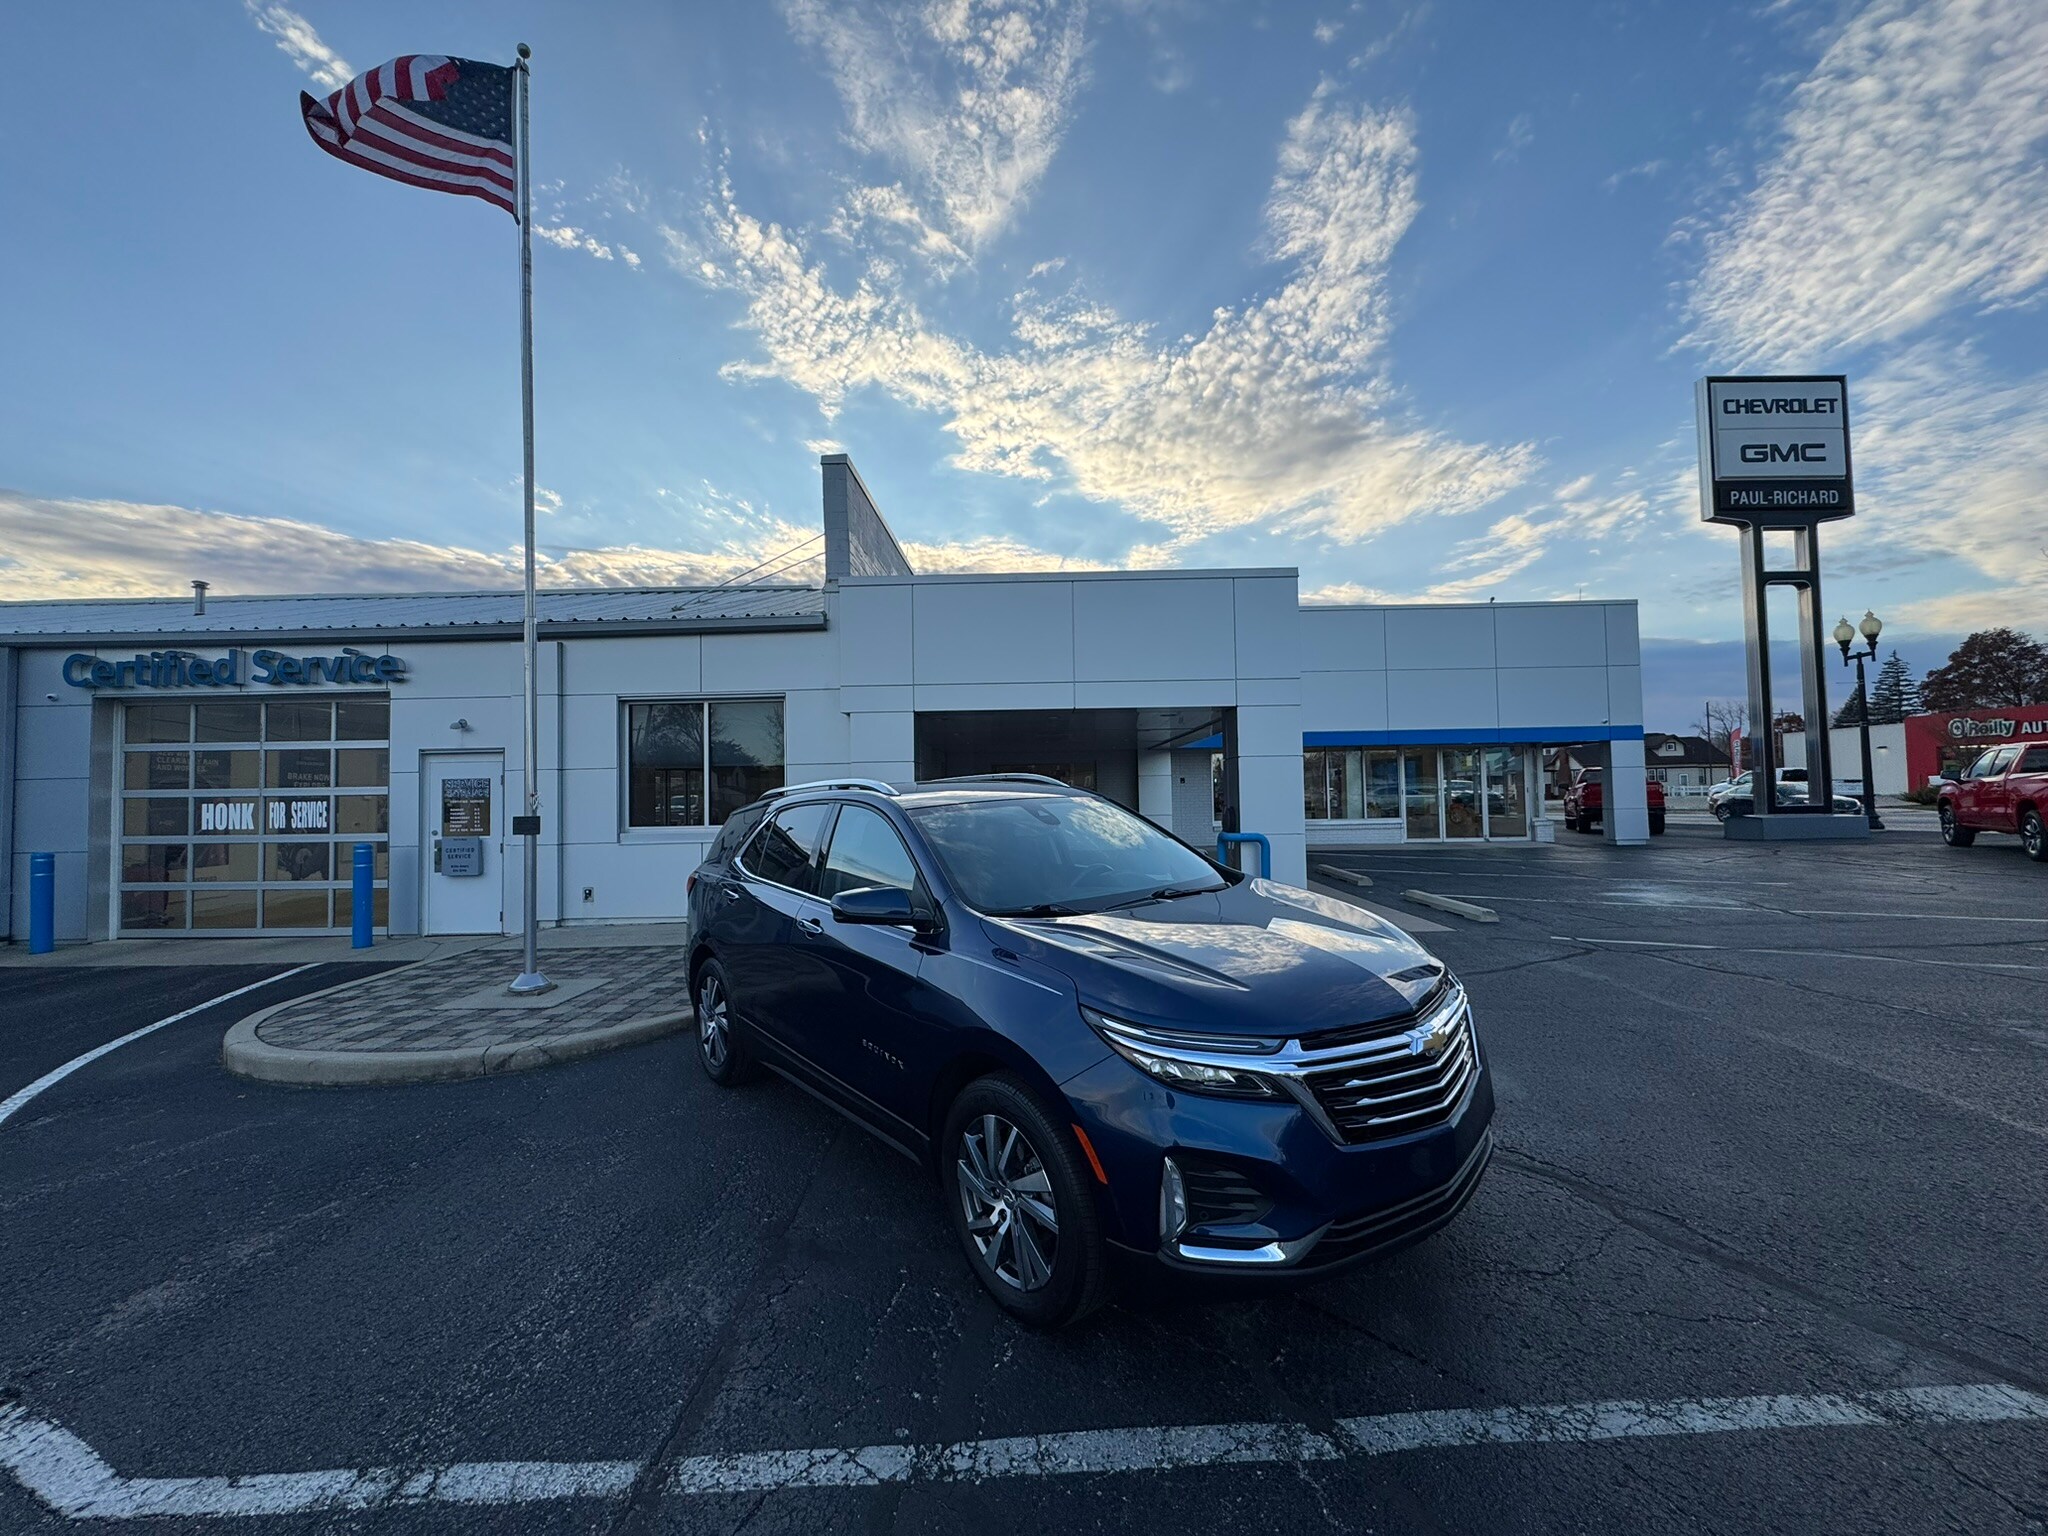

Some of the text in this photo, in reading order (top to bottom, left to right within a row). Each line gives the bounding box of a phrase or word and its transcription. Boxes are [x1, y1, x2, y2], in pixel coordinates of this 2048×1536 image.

[1722, 398, 1838, 414] CHEVROLET
[1740, 443, 1826, 463] GMC
[1730, 490, 1839, 505] PAUL-RICHARD
[63, 648, 404, 689] Certified Service
[1948, 718, 2015, 737] O'Reilly
[287, 772, 312, 780] BRAKE
[445, 779, 489, 789] SERVICE
[201, 800, 329, 830] HONK FOR SERVICE
